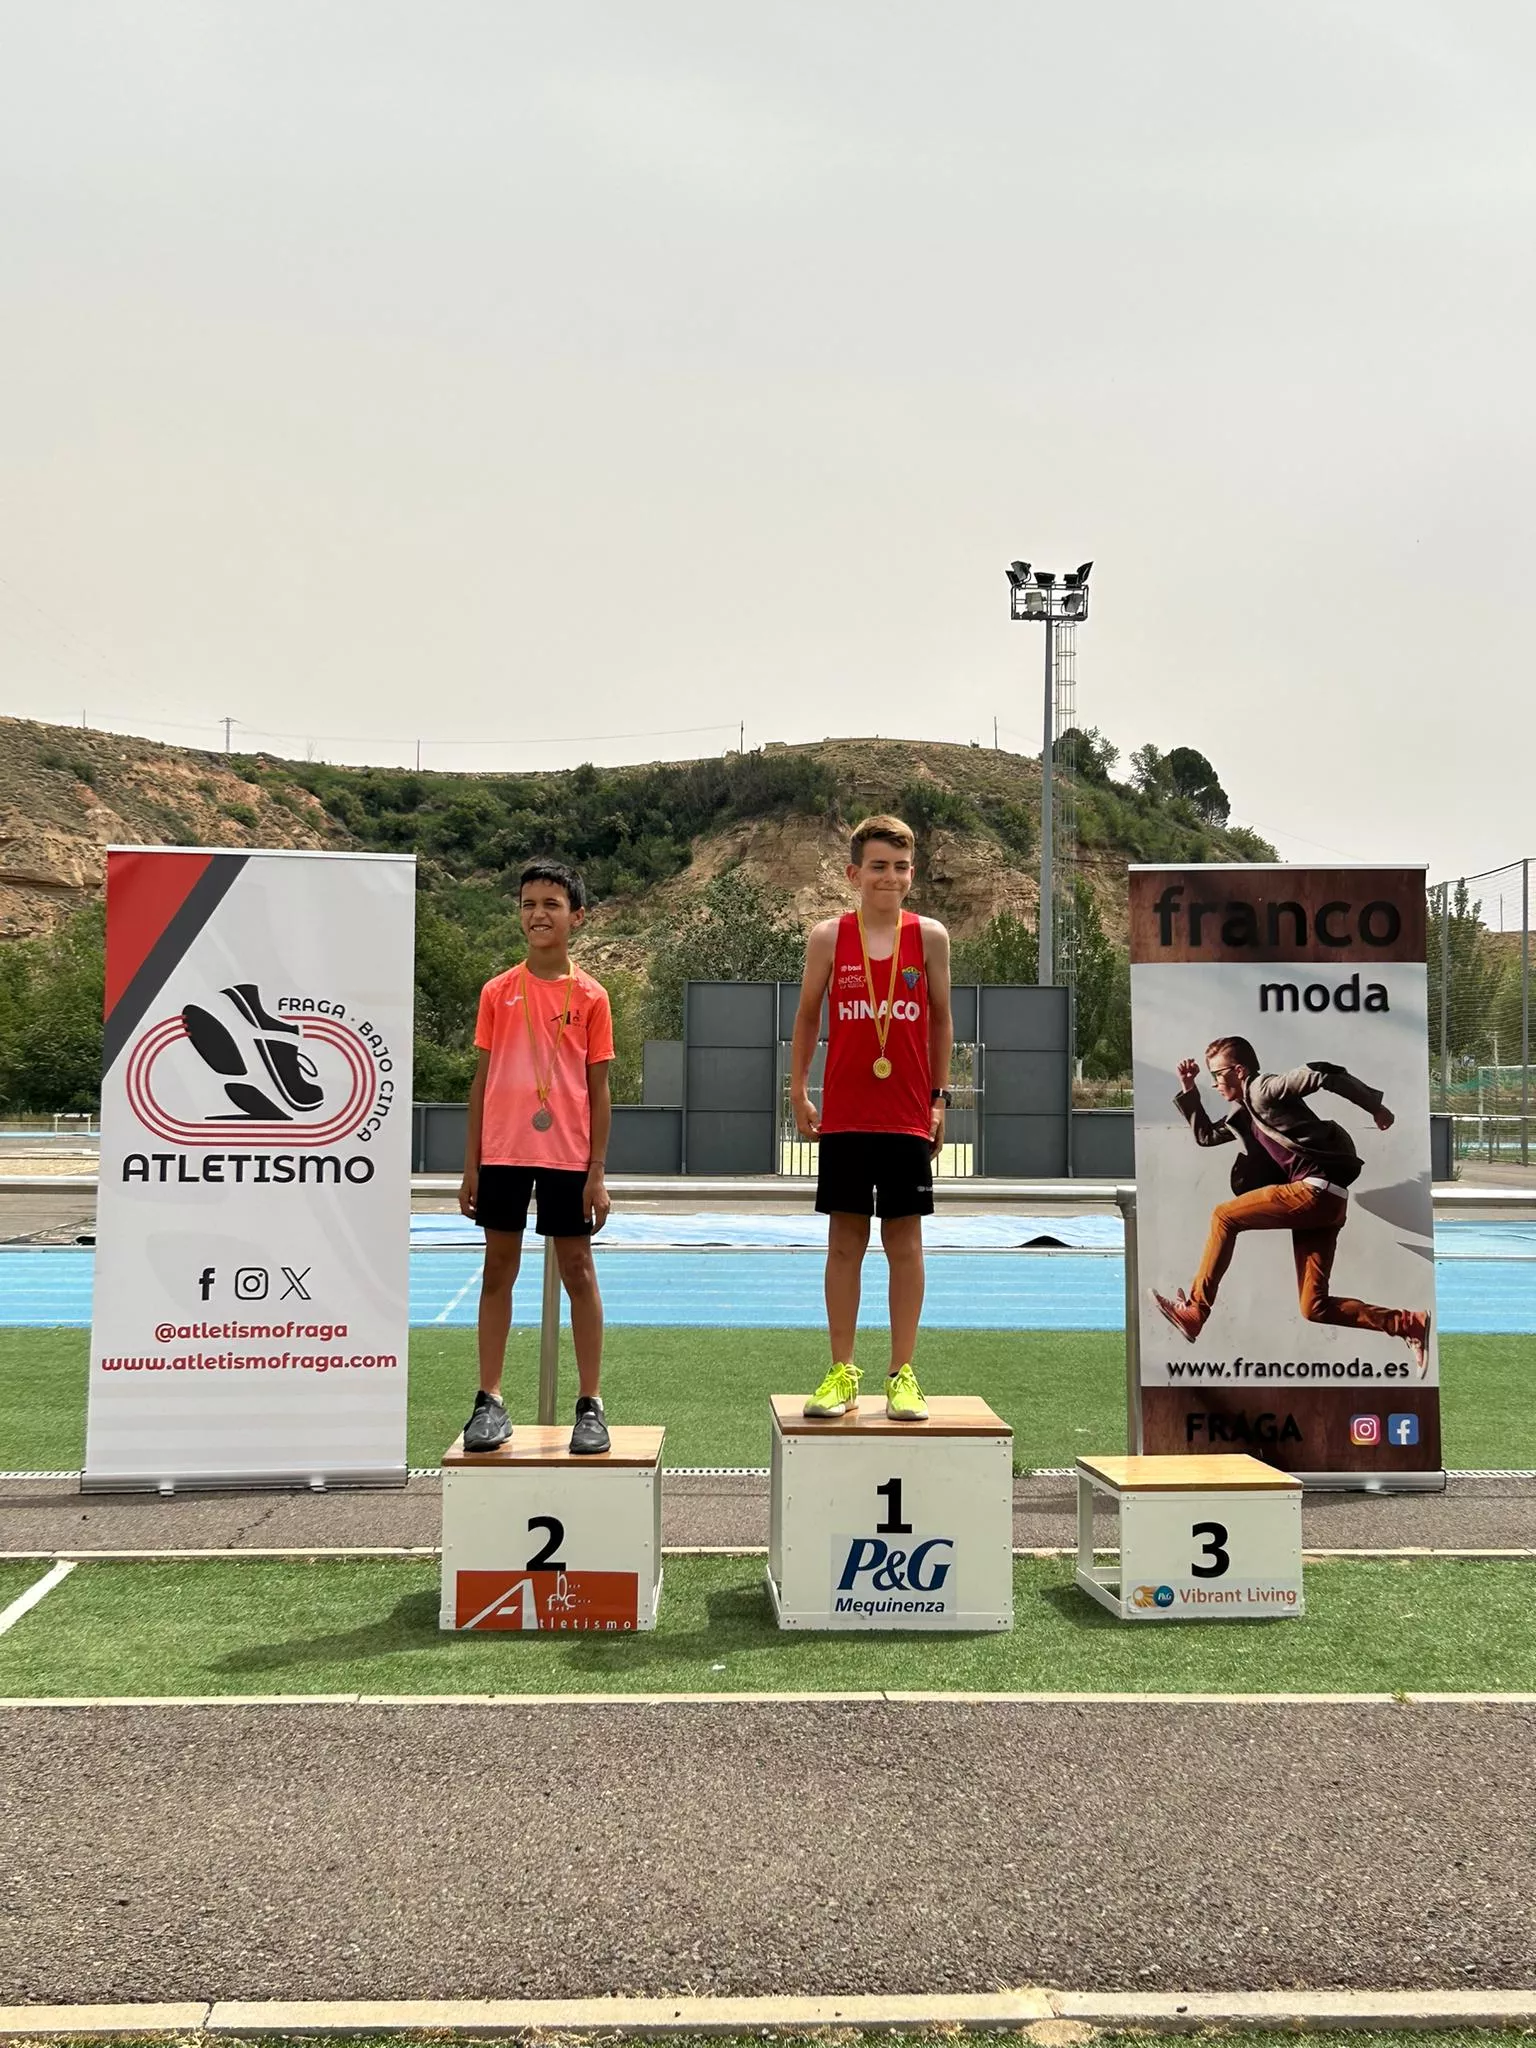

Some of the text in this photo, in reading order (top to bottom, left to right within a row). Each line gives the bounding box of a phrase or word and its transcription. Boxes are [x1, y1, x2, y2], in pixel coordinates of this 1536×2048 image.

[1153, 886, 1401, 948] franco
[1259, 973, 1390, 1013] moda
[838, 1000, 921, 1022] HINACO
[278, 997, 395, 1142] FRAGA BAJO CINCA
[122, 1153, 376, 1185] ATLETISMO
[154, 1321, 348, 1343] @atletismofraga
[101, 1352, 397, 1372] www.atletismofraga.com
[1167, 1358, 1410, 1378] www.francomoda.es
[1186, 1413, 1303, 1442] FRAGA
[877, 1478, 912, 1533] 1
[526, 1516, 566, 1571] 2
[1191, 1522, 1230, 1578] 3
[837, 1539, 954, 1591] P&G
[835, 1598, 945, 1616] Mequinenza
[1180, 1588, 1242, 1604] Vibrant
[1247, 1587, 1297, 1605] Living
